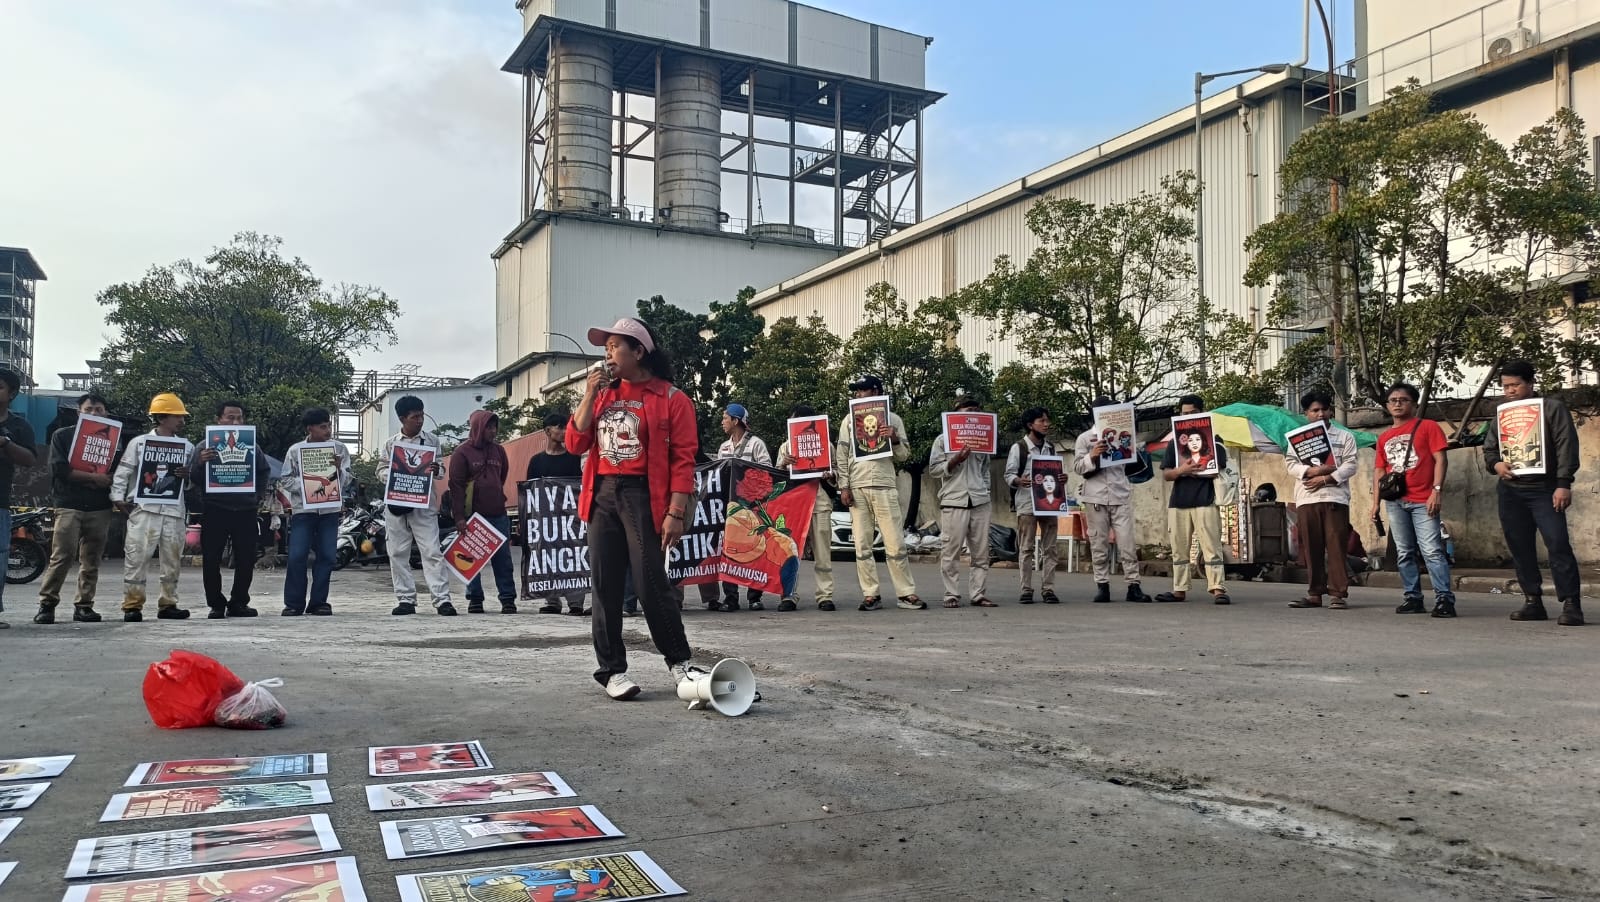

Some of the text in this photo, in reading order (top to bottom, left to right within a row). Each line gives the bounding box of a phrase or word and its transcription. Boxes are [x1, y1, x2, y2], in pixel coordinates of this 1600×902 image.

[1175, 419, 1210, 430] MARSINAH
[83, 444, 110, 456] BUKAN
[798, 440, 821, 450] BUKAN
[145, 451, 184, 464] OLIGARKI
[526, 485, 583, 513] NYA
[528, 546, 590, 575] ANGK
[528, 577, 588, 592] KESELAMATAN
[683, 564, 716, 578] ADALAH
[728, 564, 768, 583] MANUSIA
